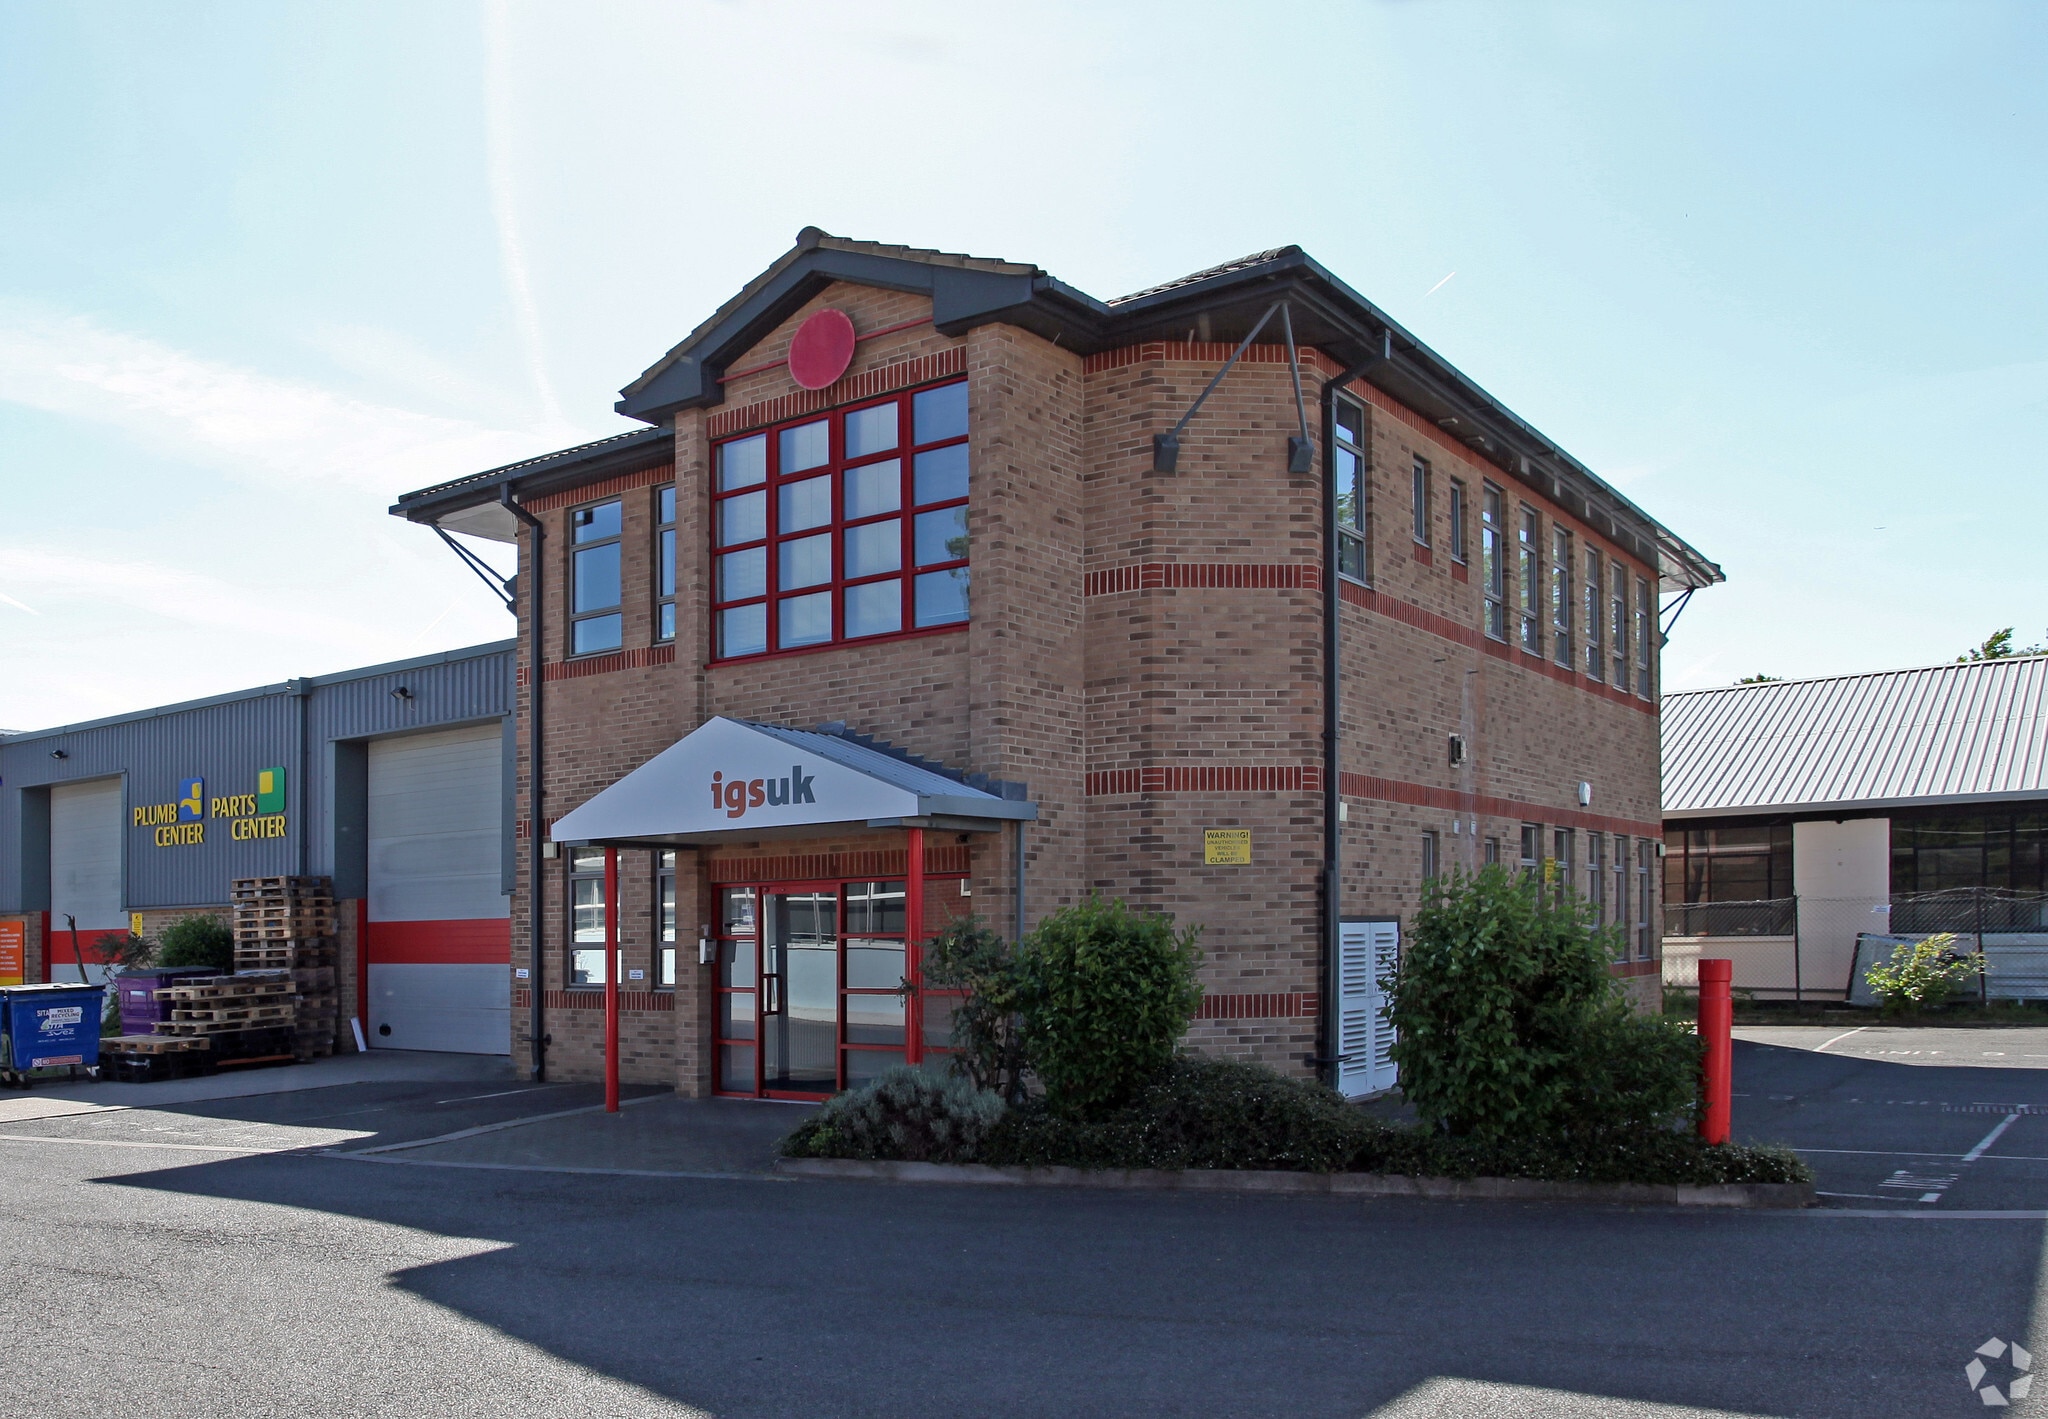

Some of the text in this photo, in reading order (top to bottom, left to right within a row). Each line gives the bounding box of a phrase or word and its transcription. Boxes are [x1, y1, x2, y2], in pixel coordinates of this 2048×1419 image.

[711, 765, 816, 818] igsuk
[134, 803, 178, 826] PLUMB
[211, 794, 256, 818] PARTS
[155, 823, 204, 847] CENTER
[231, 815, 286, 841] CENTER
